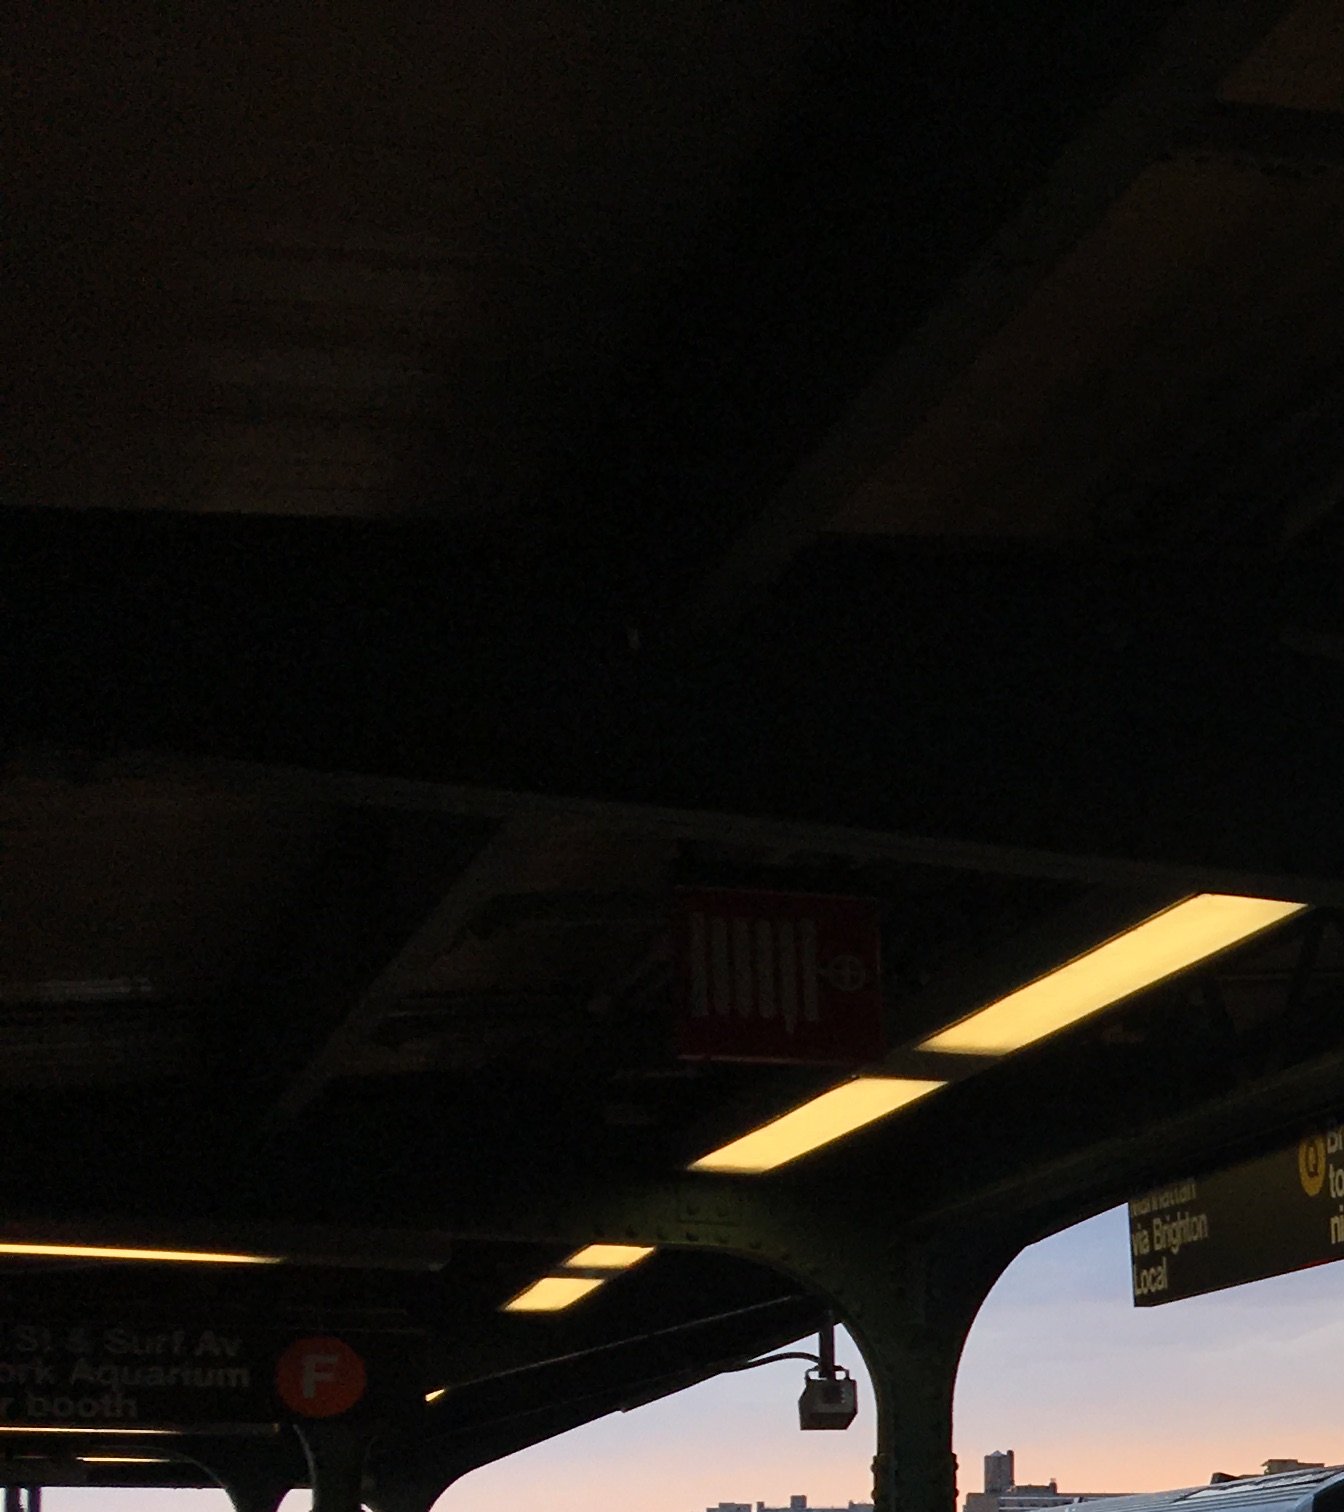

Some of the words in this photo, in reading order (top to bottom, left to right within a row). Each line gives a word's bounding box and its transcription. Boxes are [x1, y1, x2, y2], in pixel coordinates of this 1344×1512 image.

[1152, 1211, 1209, 1254] Brighton
[1134, 1256, 1168, 1296] Local
[104, 1326, 187, 1355] Surf
[193, 1329, 243, 1358] Av
[69, 1357, 251, 1391] Aquarium
[301, 1352, 340, 1400] F
[26, 1388, 139, 1418] booth
